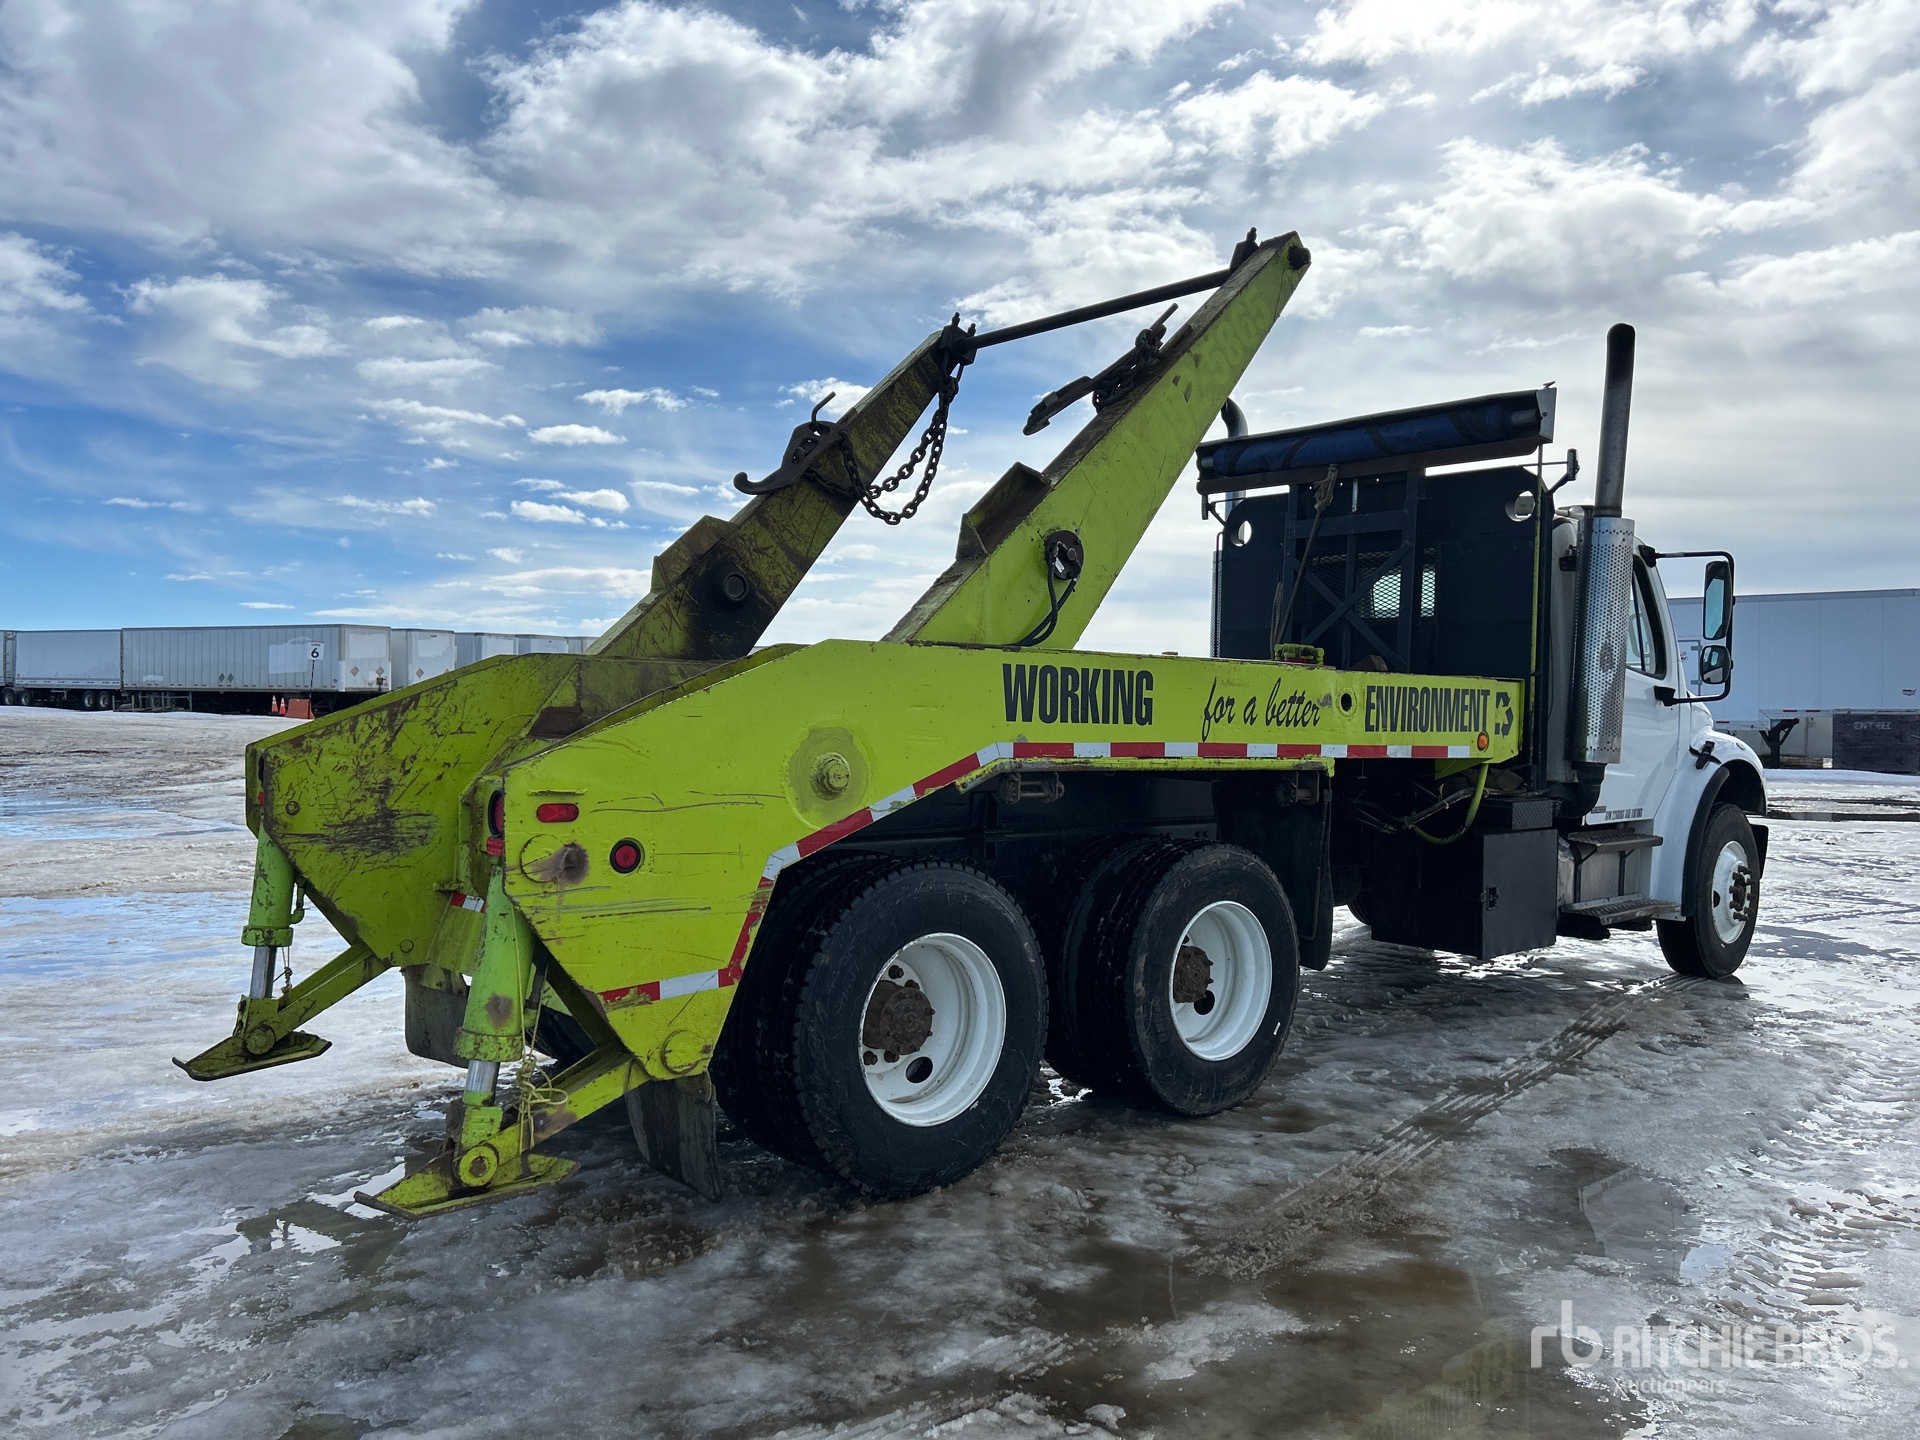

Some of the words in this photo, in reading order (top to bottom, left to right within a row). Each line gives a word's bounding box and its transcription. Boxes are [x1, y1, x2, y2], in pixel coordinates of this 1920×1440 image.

[311, 647, 319, 658] 6
[1002, 663, 1154, 726] WORKING
[1201, 676, 1236, 743] for
[1243, 695, 1259, 726] a
[1265, 676, 1321, 728] better
[1364, 685, 1491, 733] ENVIRONMENT
